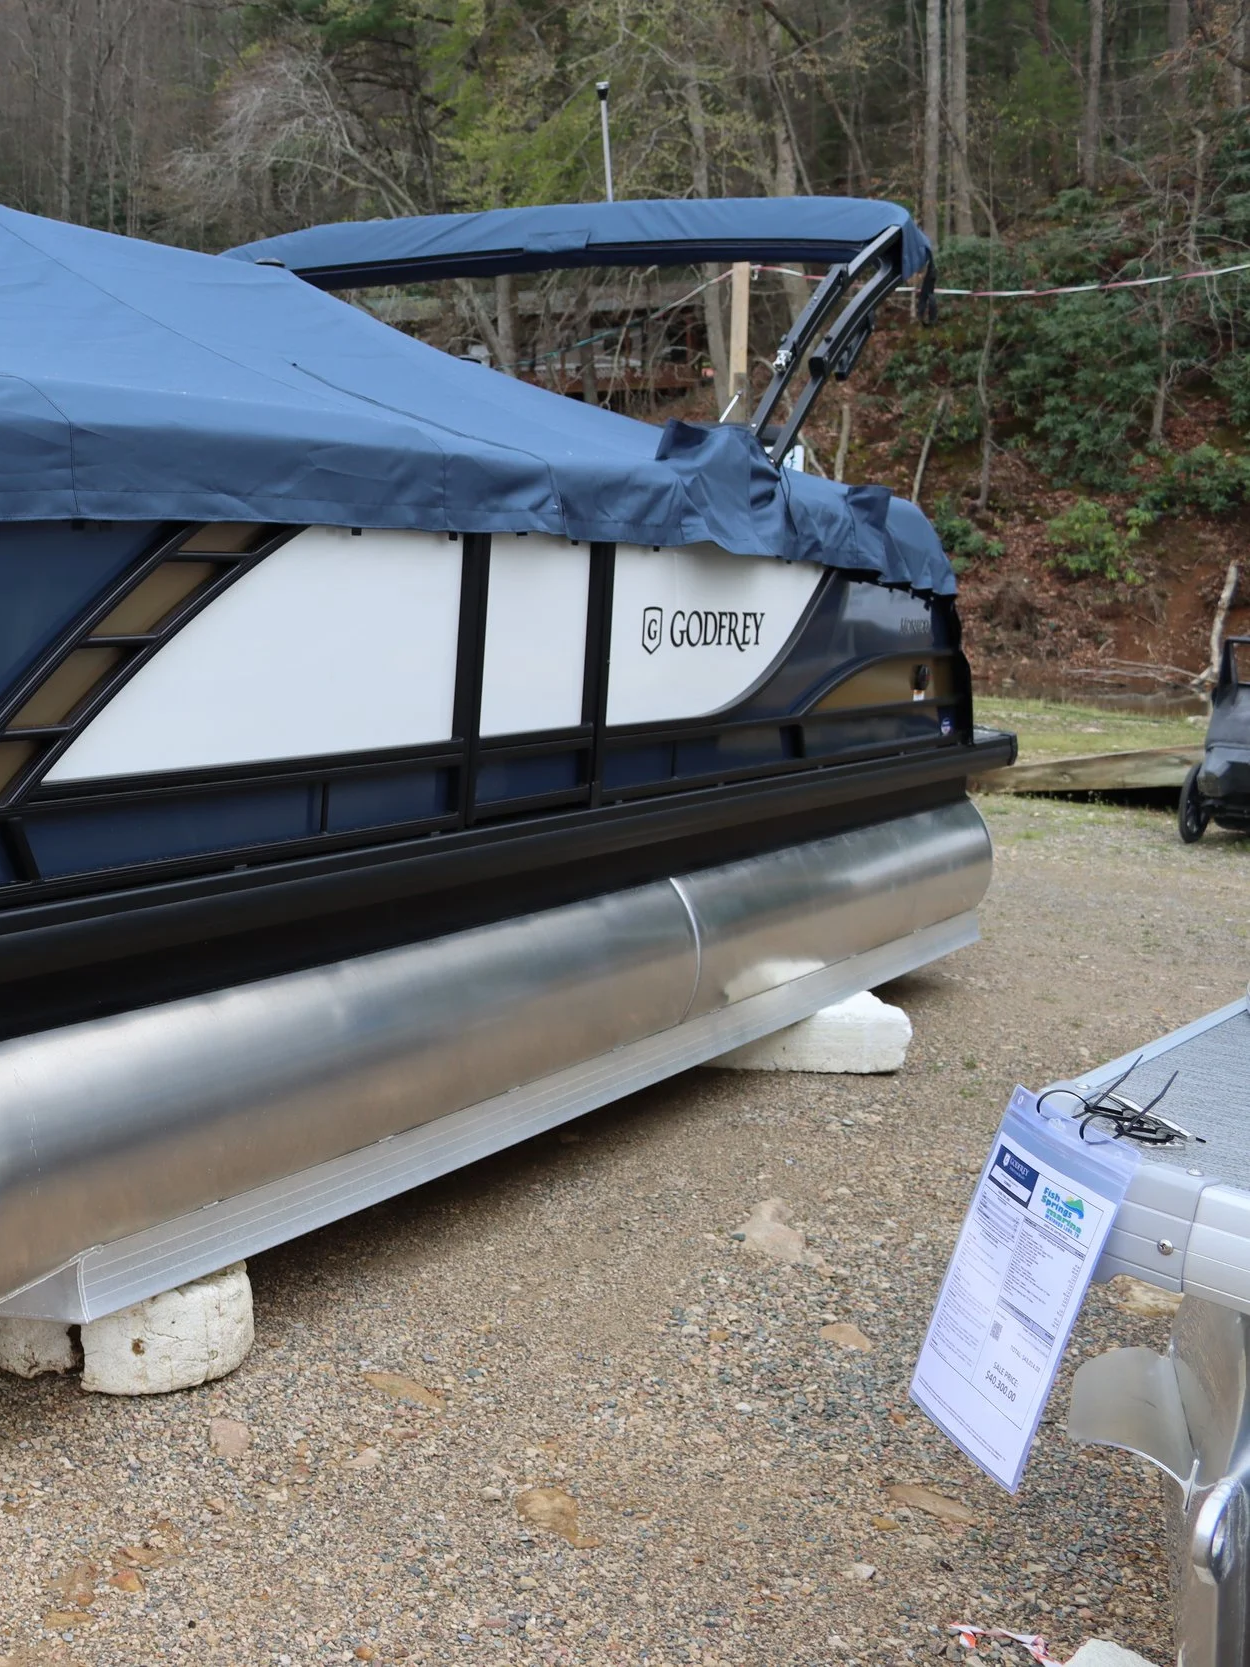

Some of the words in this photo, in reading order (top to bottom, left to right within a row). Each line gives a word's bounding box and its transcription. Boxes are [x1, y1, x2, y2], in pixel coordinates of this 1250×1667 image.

[669, 609, 766, 653] GODFREY
[1040, 1194, 1073, 1219] Springs
[1043, 1186, 1061, 1203] Fish
[1045, 1207, 1083, 1235] marina
[992, 1361, 1006, 1376] SALE
[985, 1369, 1017, 1402] $40,300.00
